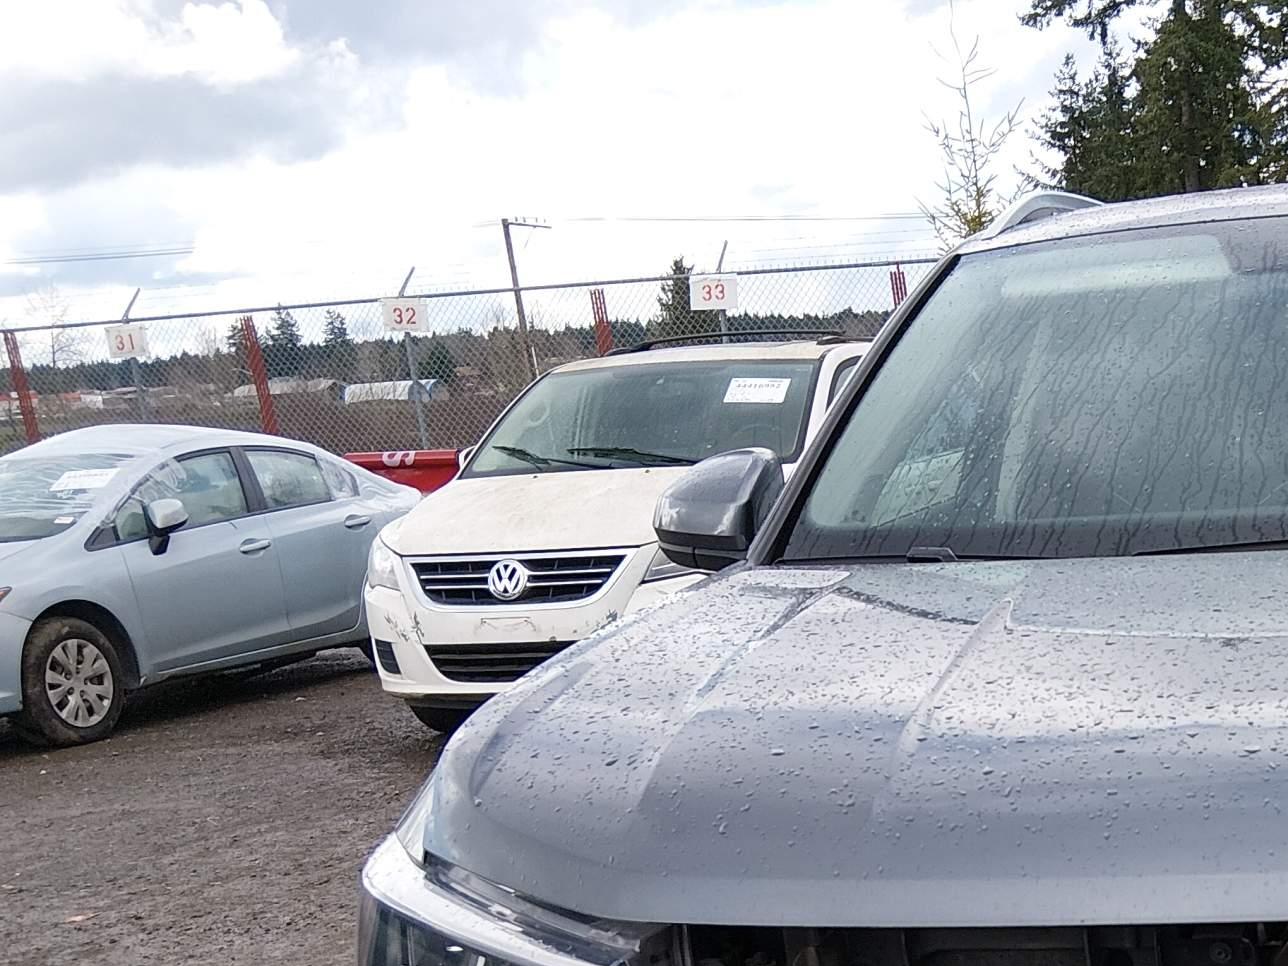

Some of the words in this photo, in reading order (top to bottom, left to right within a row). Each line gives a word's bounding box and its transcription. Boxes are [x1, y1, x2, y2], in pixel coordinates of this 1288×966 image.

[702, 283, 725, 301] 33
[392, 306, 417, 325] 32
[115, 333, 135, 351] 31
